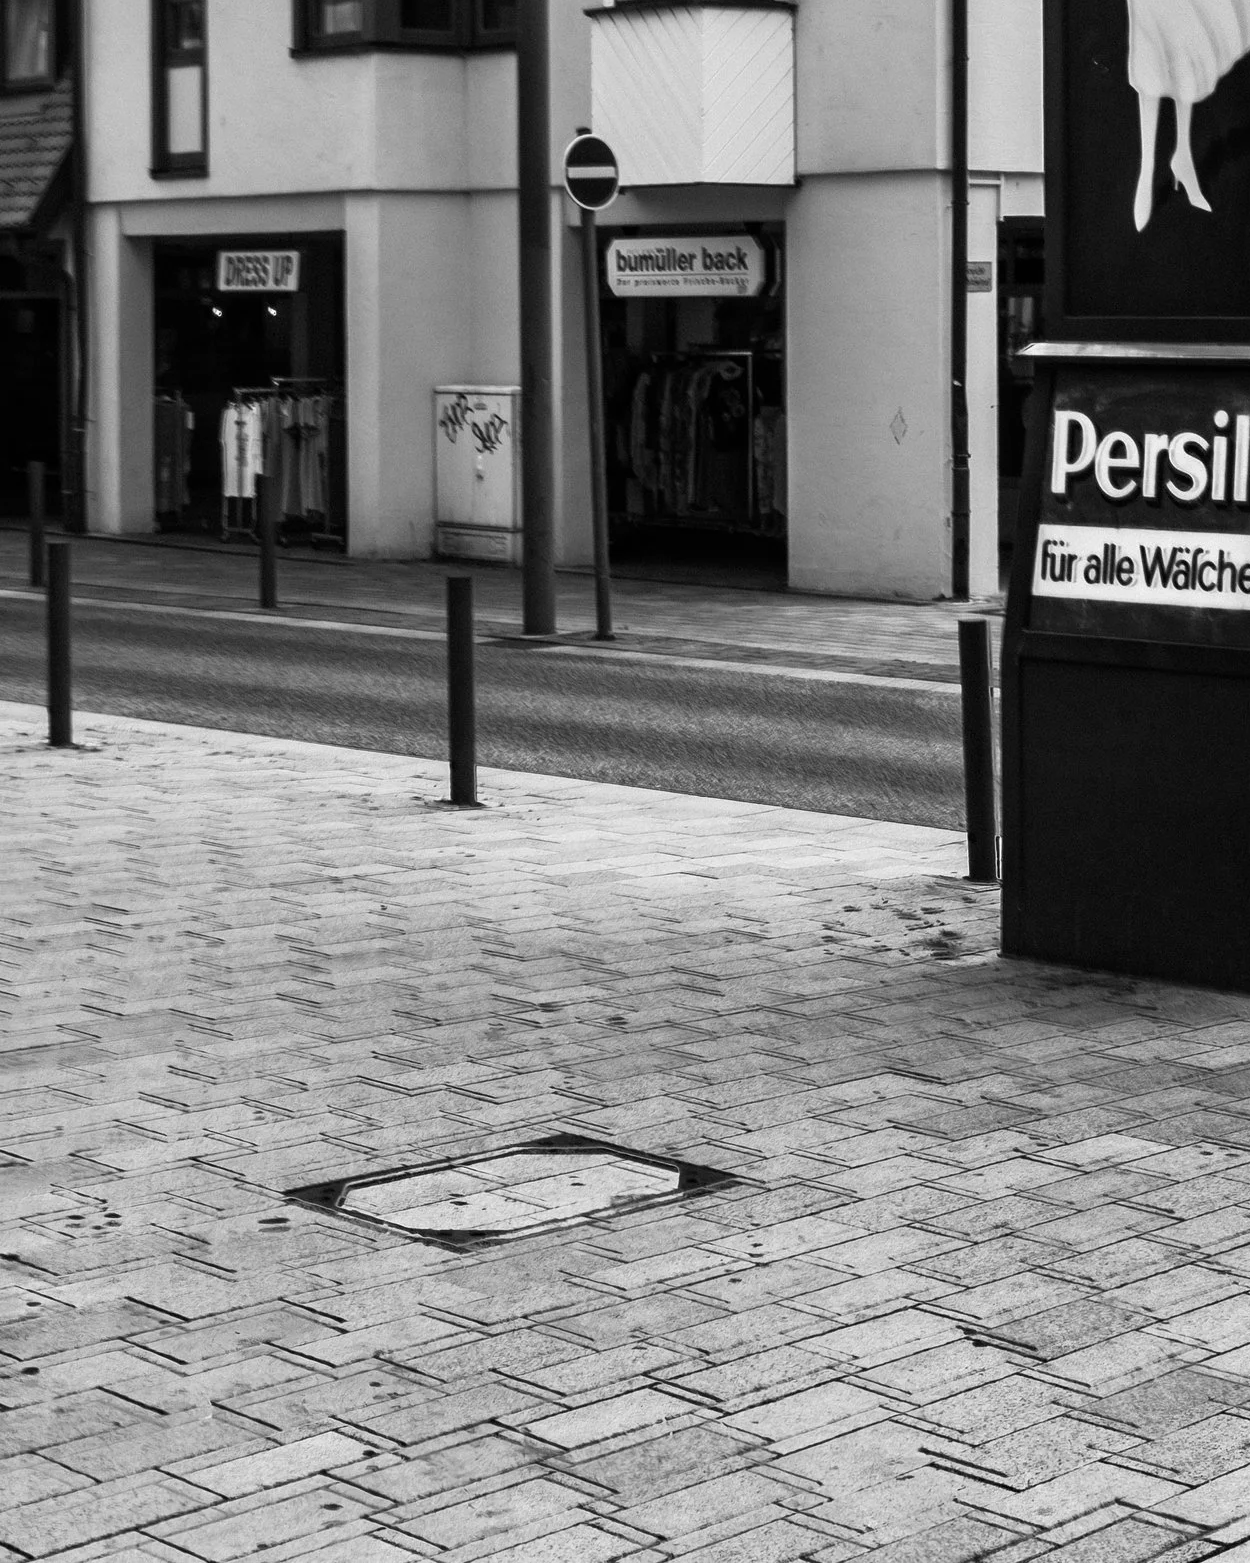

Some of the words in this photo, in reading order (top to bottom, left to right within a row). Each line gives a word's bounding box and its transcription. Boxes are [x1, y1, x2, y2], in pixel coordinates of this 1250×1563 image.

[272, 254, 294, 287] UP
[616, 246, 697, 272] bumüller
[701, 245, 749, 271] back
[1050, 409, 1250, 503] Persil
[1040, 538, 1078, 583] für
[1082, 543, 1135, 586] alle
